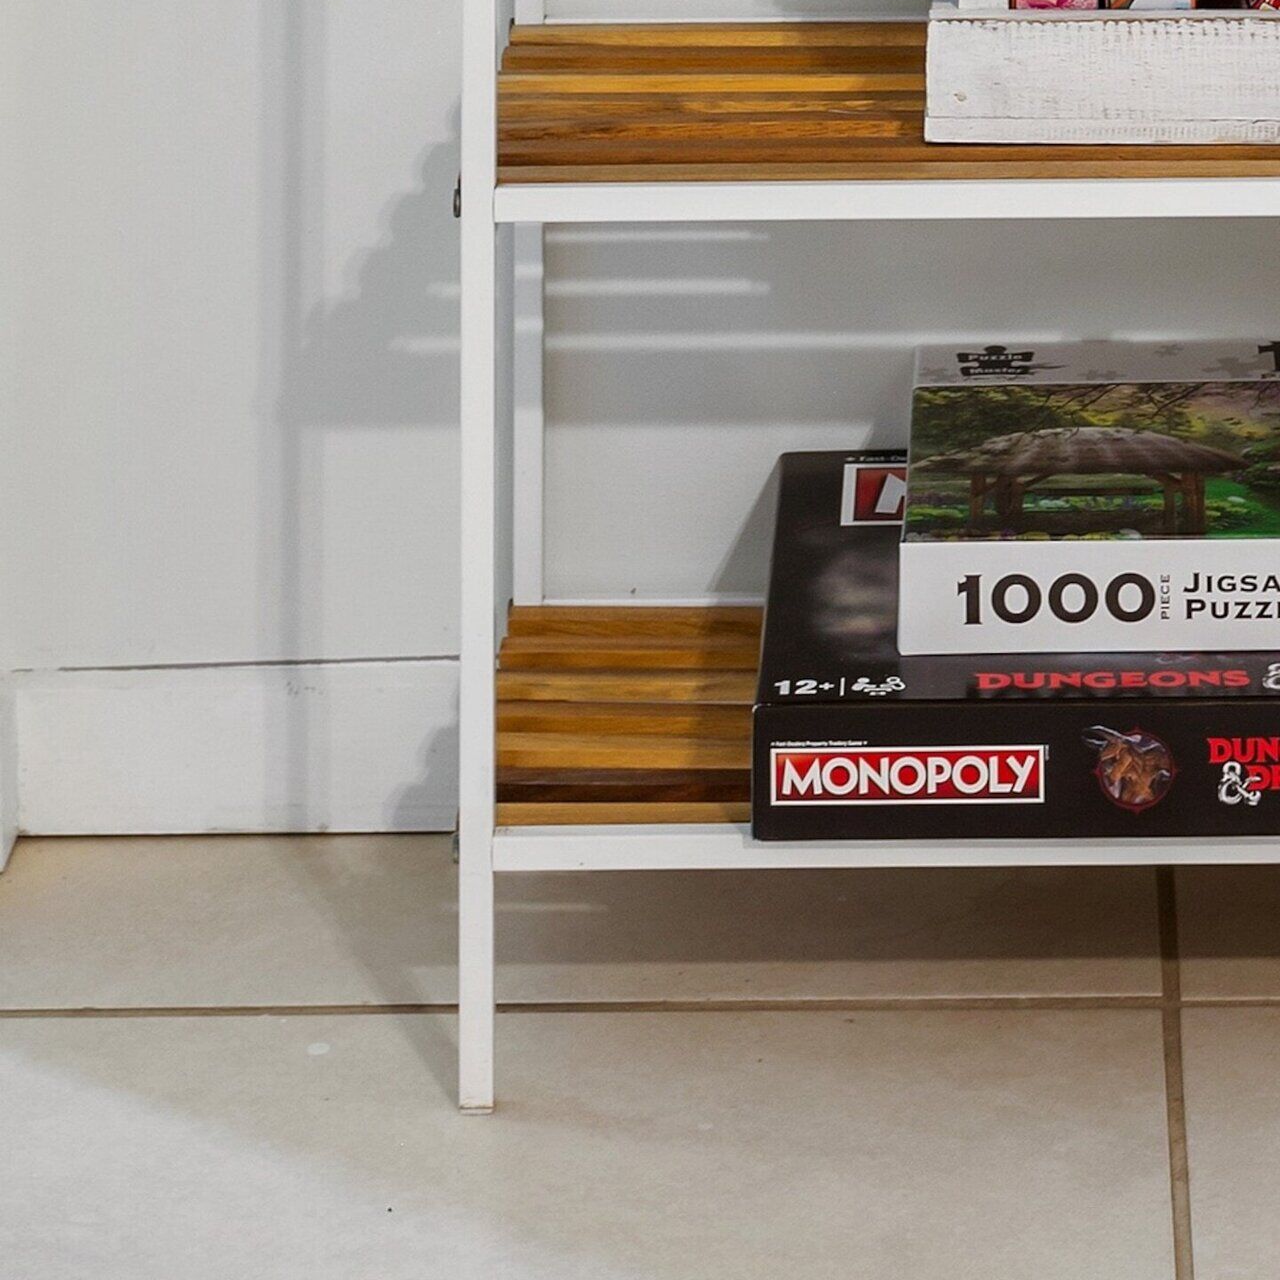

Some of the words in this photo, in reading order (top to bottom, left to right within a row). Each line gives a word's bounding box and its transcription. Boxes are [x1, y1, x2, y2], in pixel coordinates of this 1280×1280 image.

[957, 572, 1156, 625] 1000
[1160, 574, 1171, 621] PIECE
[774, 679, 835, 696] 12+
[975, 670, 1250, 690] DUNGEONS
[781, 755, 1036, 796] MONOPOLY
[1217, 761, 1262, 806] &
